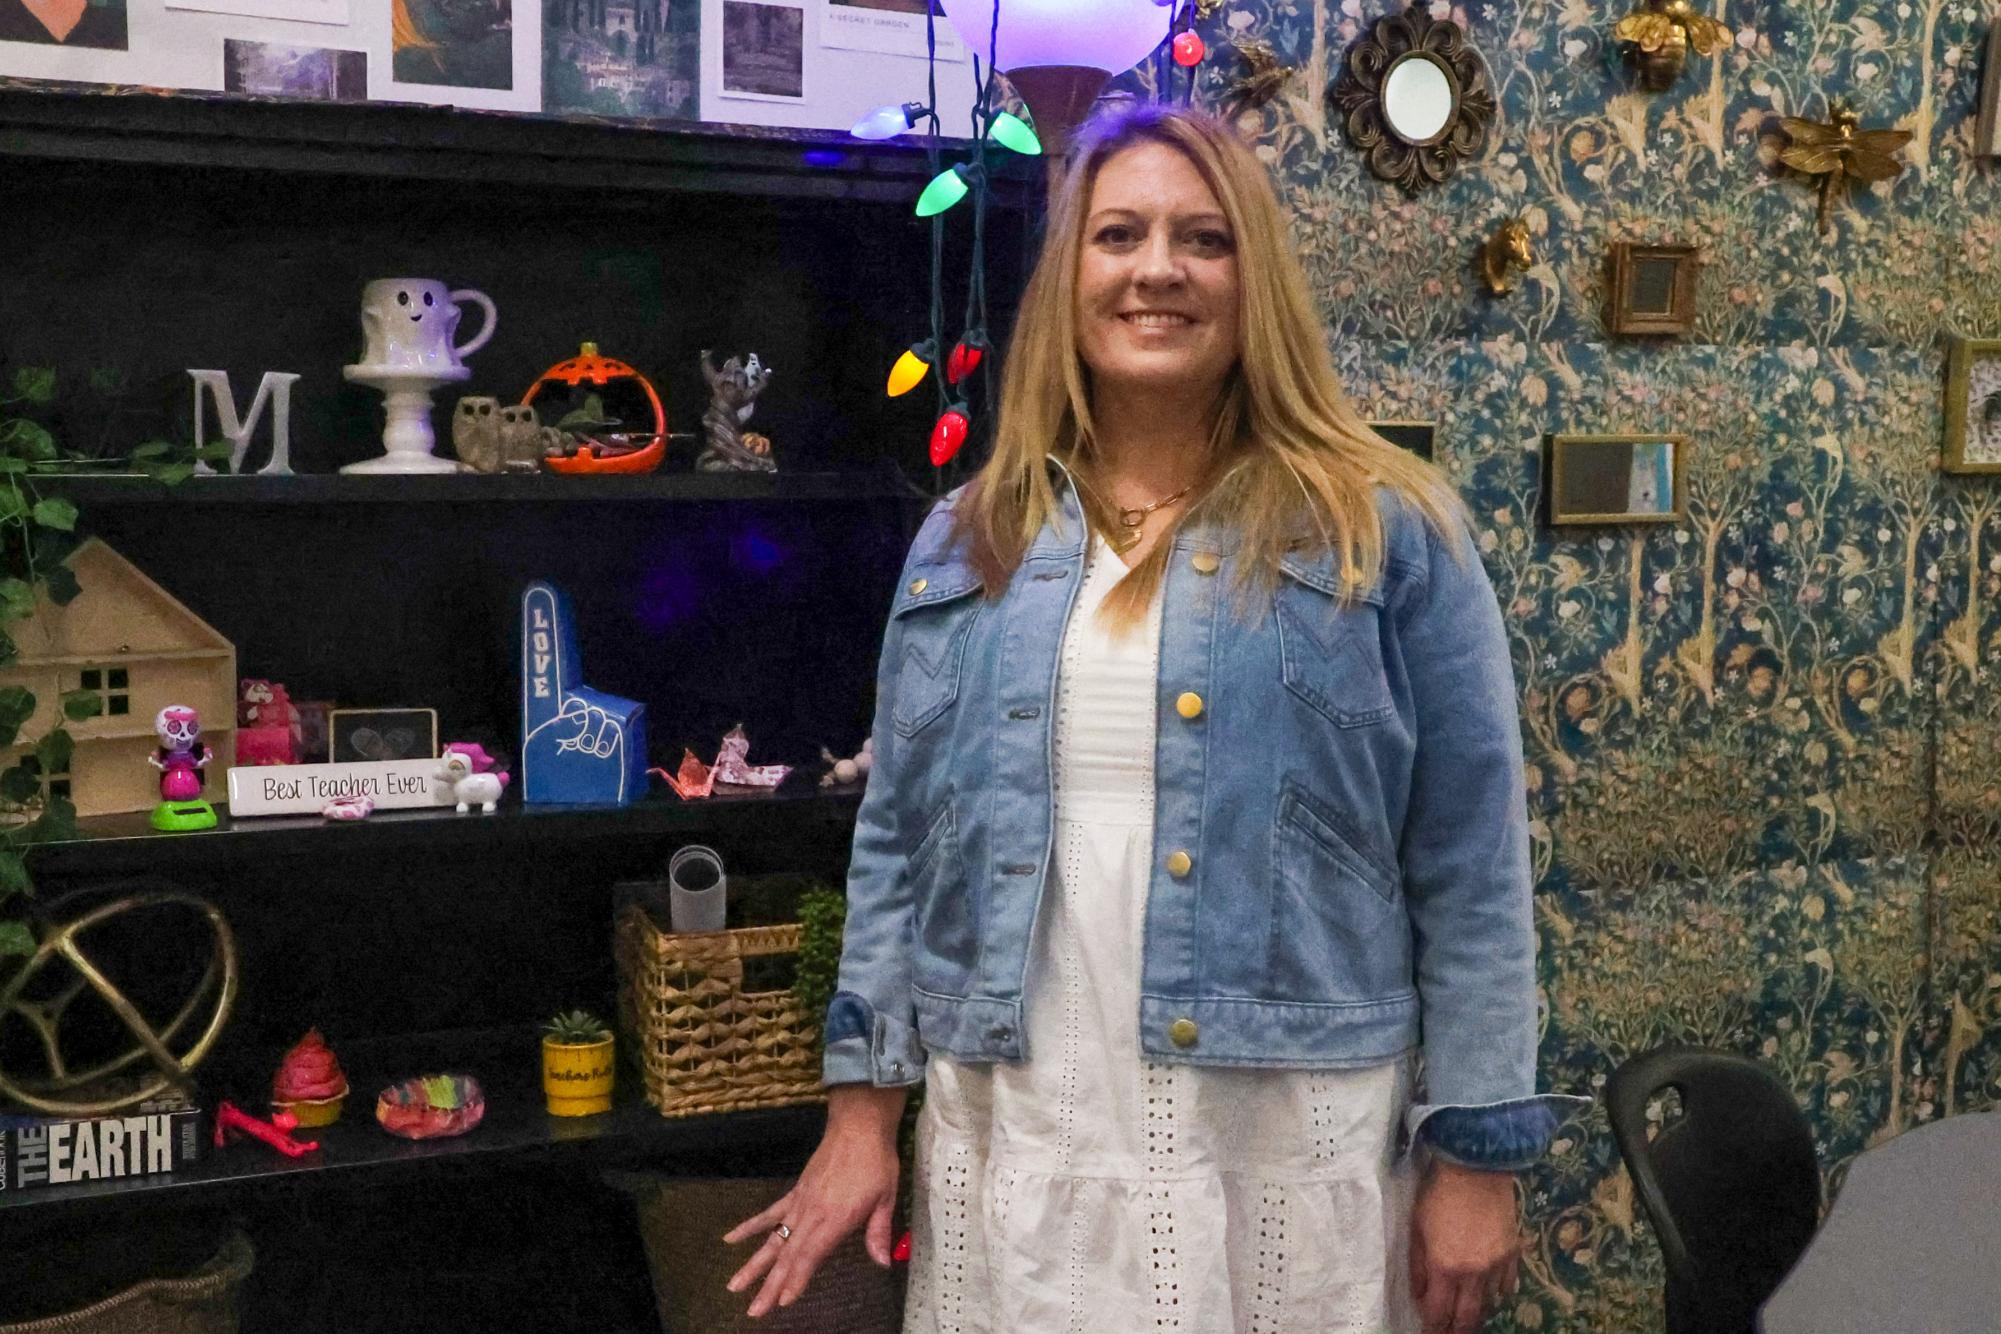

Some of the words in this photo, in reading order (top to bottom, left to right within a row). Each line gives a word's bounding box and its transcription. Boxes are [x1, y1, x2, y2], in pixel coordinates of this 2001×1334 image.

[186, 368, 302, 475] M
[533, 608, 551, 698] LOVE
[263, 777, 302, 801] Best
[307, 771, 382, 798] Teacher
[386, 772, 428, 796] Ever
[17, 1124, 48, 1189] THE
[49, 1113, 173, 1184] EARTH
